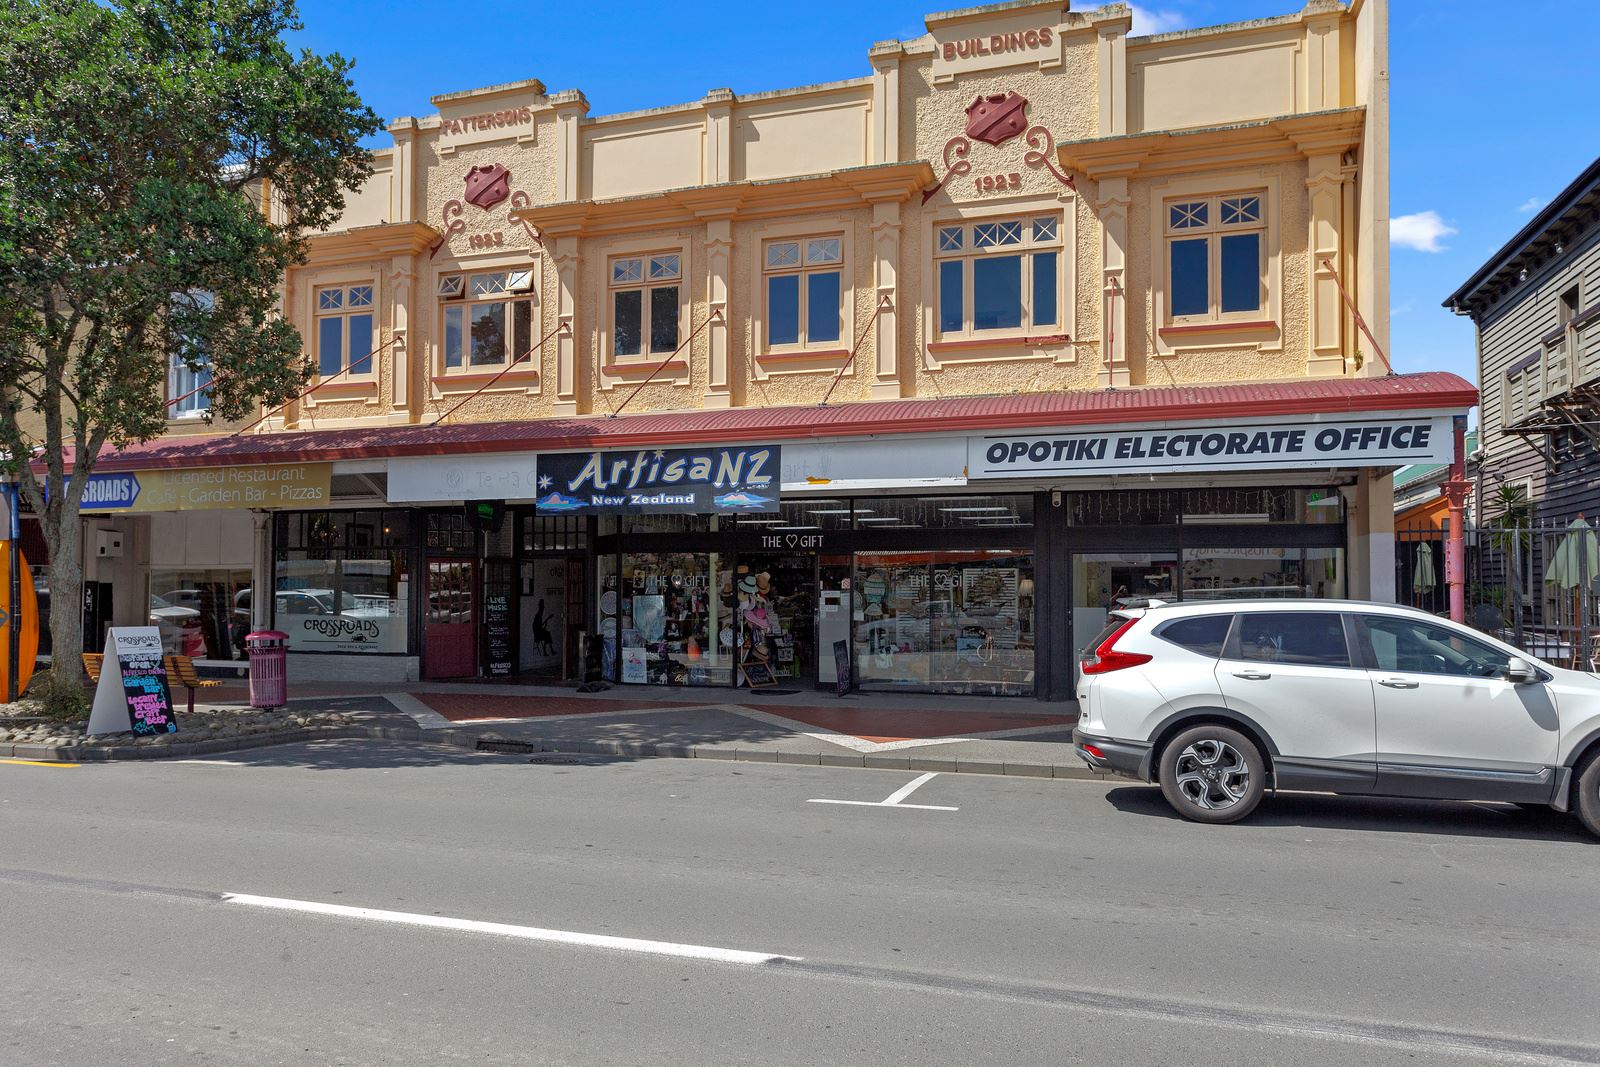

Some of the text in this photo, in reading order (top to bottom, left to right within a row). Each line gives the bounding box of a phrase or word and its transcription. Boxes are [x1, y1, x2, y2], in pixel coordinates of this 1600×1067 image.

[943, 27, 1053, 61] BUILDINGS
[440, 107, 531, 135] PATTERSONS
[975, 172, 1022, 191] 1923
[469, 231, 503, 249] 1923
[986, 425, 1432, 464] OPOTIKI ELECTORATE OFFICE
[229, 467, 305, 482] Restaurant
[190, 487, 240, 502] Garden
[245, 486, 268, 501] Bar
[280, 484, 322, 501] Pizzas
[592, 493, 694, 505] New Zealand
[761, 535, 824, 547] THE GIFT
[684, 575, 706, 587] GIFT
[303, 620, 380, 638] CROSSROADS
[117, 635, 160, 646] CROSSROADS
